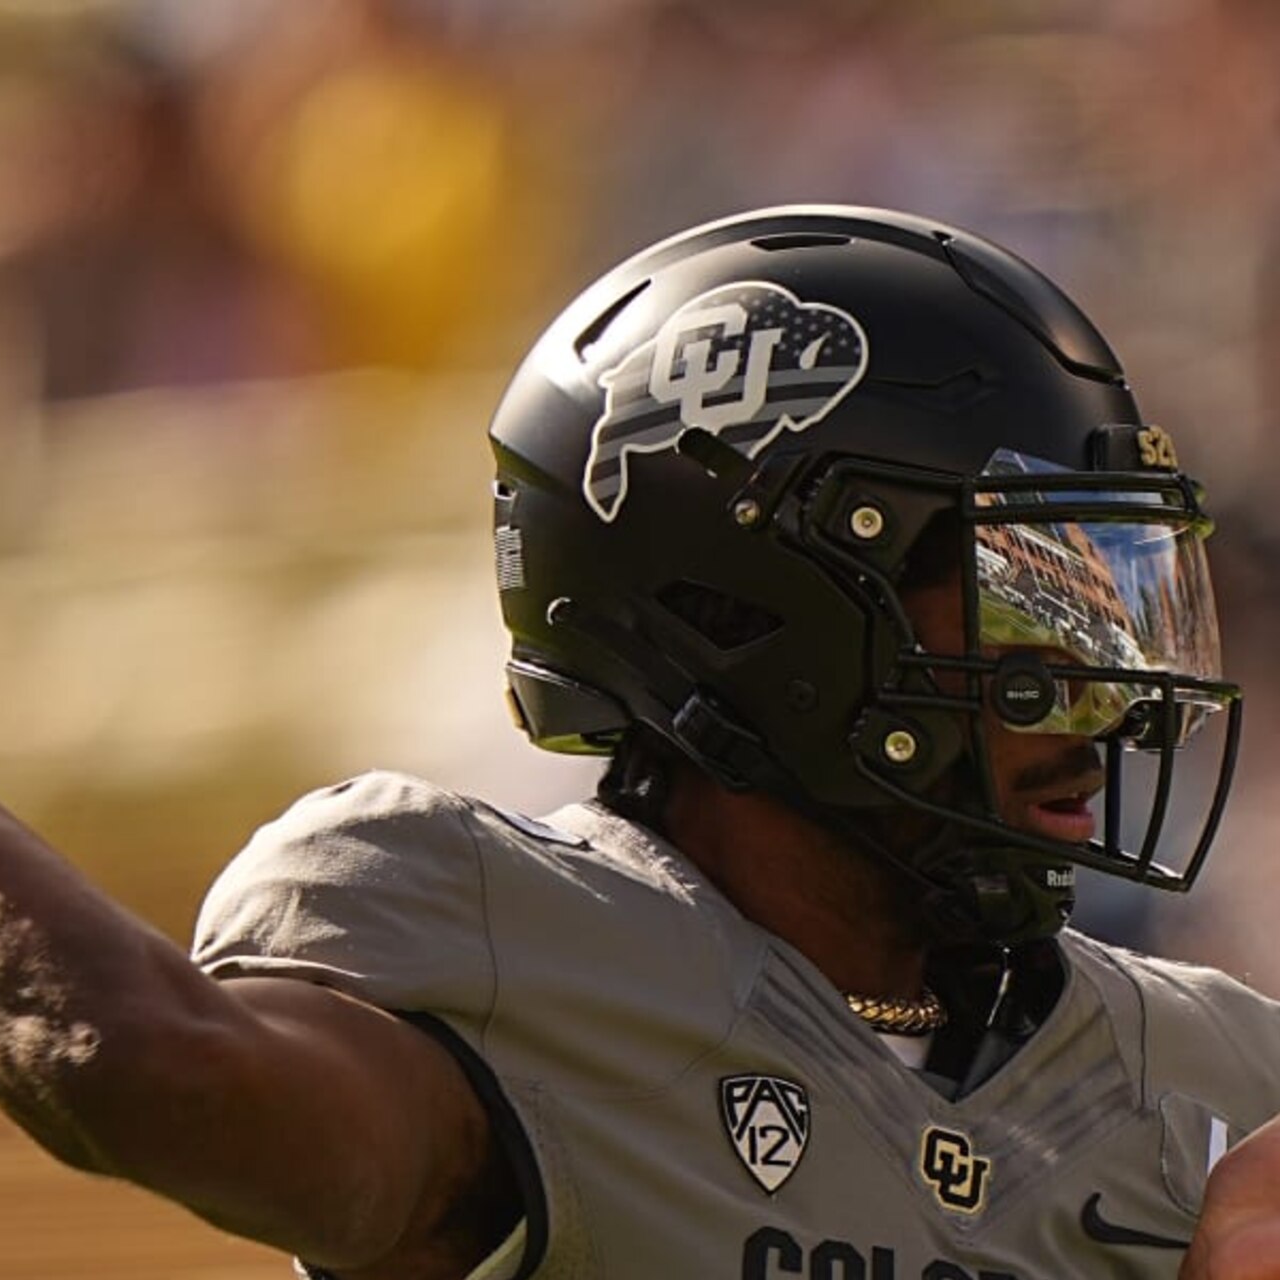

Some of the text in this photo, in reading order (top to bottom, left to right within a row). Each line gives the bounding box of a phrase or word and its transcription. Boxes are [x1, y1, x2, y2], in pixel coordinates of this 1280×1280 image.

[724, 1079, 807, 1146] PAC
[748, 1126, 791, 1167] 12
[921, 1125, 990, 1214] CU
